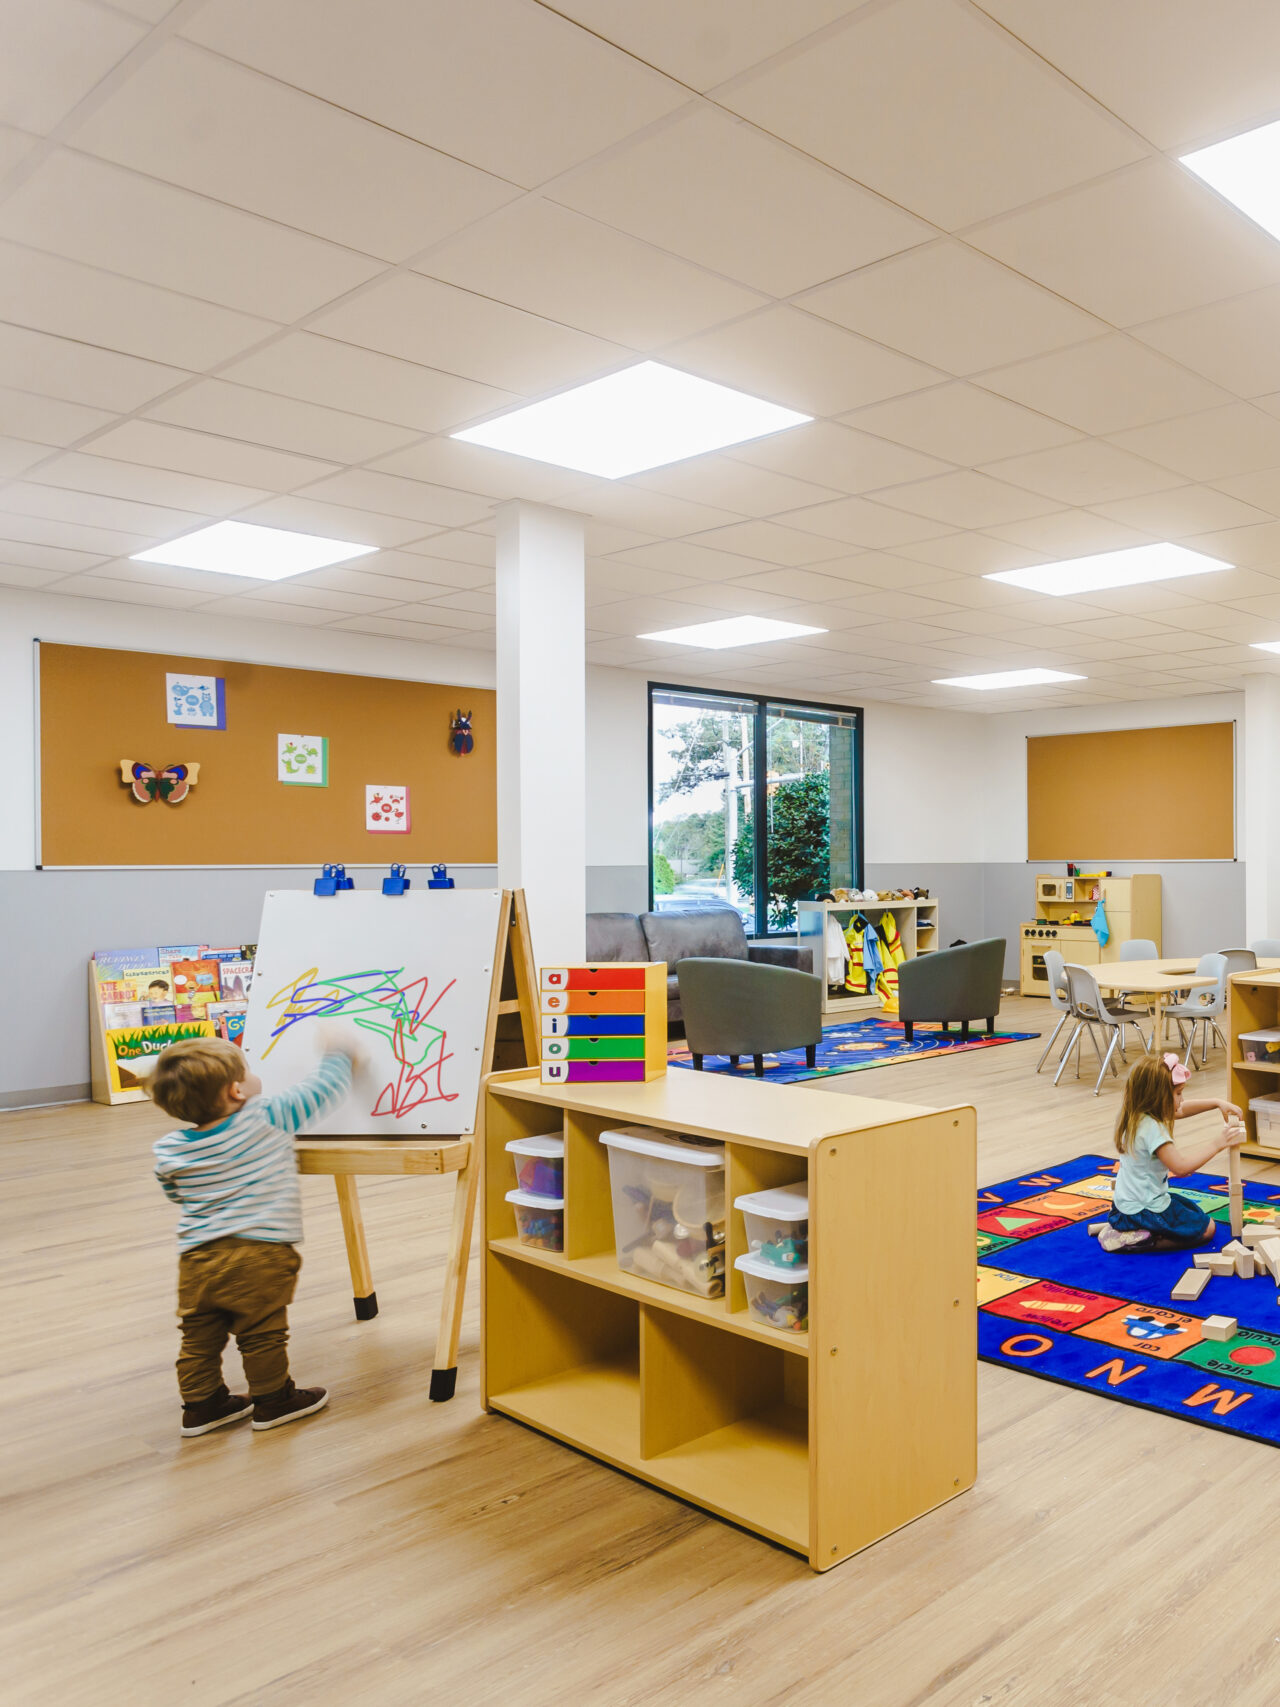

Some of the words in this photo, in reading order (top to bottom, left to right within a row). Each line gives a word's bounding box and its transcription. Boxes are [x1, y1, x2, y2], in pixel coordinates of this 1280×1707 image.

[222, 966, 255, 975] SPACECRA
[548, 973, 561, 984] a
[99, 982, 118, 991] THE
[548, 997, 560, 1008] e
[551, 1018, 557, 1033] i
[118, 1045, 142, 1057] One
[549, 1043, 561, 1054] o
[549, 1066, 561, 1077] u
[1019, 1174, 1063, 1188] W
[1041, 1283, 1099, 1301] amarillo
[1135, 1306, 1176, 1319] carro
[1021, 1313, 1073, 1328] yellow
[999, 1333, 1054, 1357] O
[1132, 1341, 1161, 1352] car
[1085, 1358, 1147, 1386] N
[1206, 1359, 1253, 1377] circle
[1182, 1383, 1254, 1416] M
